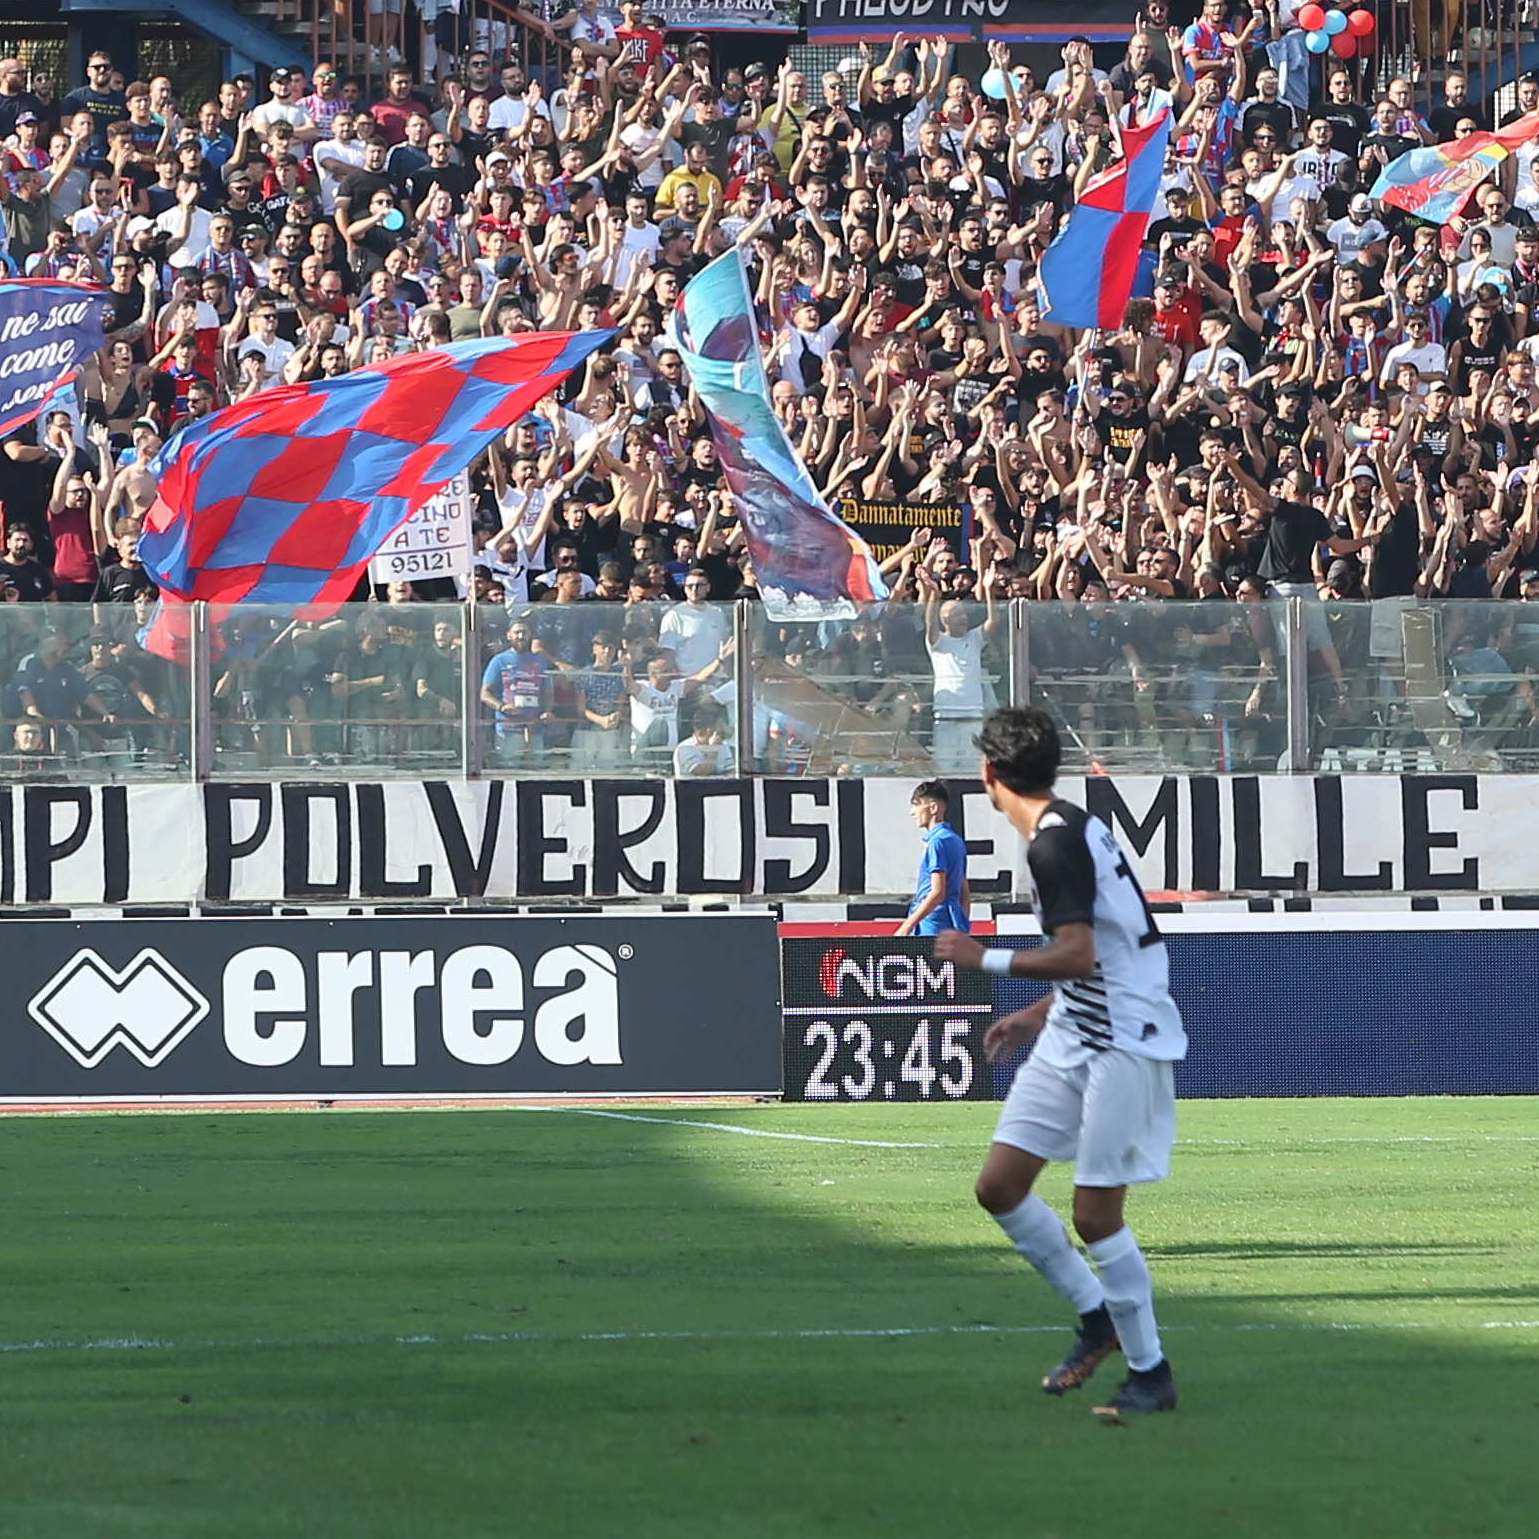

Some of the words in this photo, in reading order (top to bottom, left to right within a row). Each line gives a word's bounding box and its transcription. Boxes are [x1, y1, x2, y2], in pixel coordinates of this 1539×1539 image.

[0, 311, 40, 343] ne
[39, 297, 94, 331] sai
[0, 339, 76, 379] come
[840, 498, 963, 527] Dannatamente
[394, 530, 410, 549] A
[419, 526, 451, 545] TE
[391, 551, 454, 574] 95121
[205, 780, 865, 898] POLVEROSI
[1085, 772, 1479, 892] MILLE
[837, 954, 956, 1000] NGM
[802, 1019, 975, 1100] 23:45
